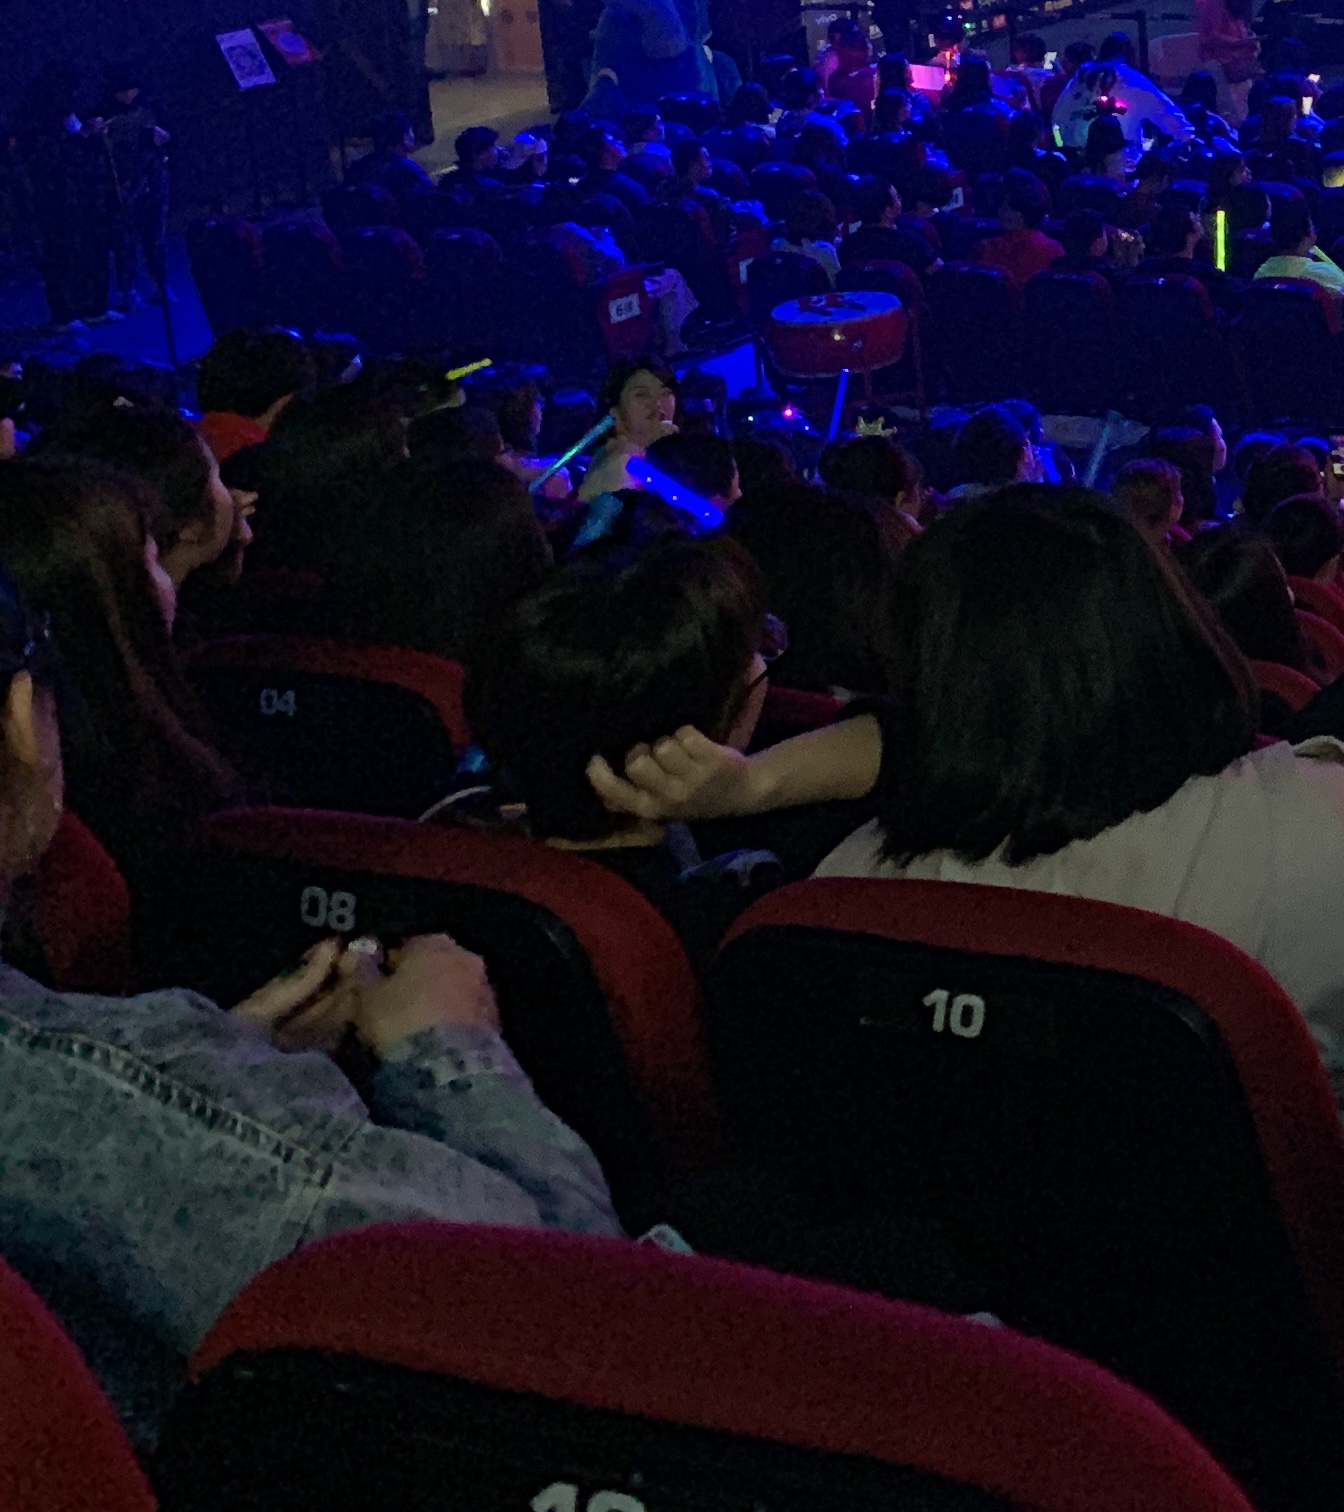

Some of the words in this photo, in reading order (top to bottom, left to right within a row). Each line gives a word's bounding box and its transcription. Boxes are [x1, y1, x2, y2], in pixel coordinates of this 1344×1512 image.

[260, 688, 297, 717] 04
[300, 886, 357, 932] 08
[923, 988, 986, 1039] 10
